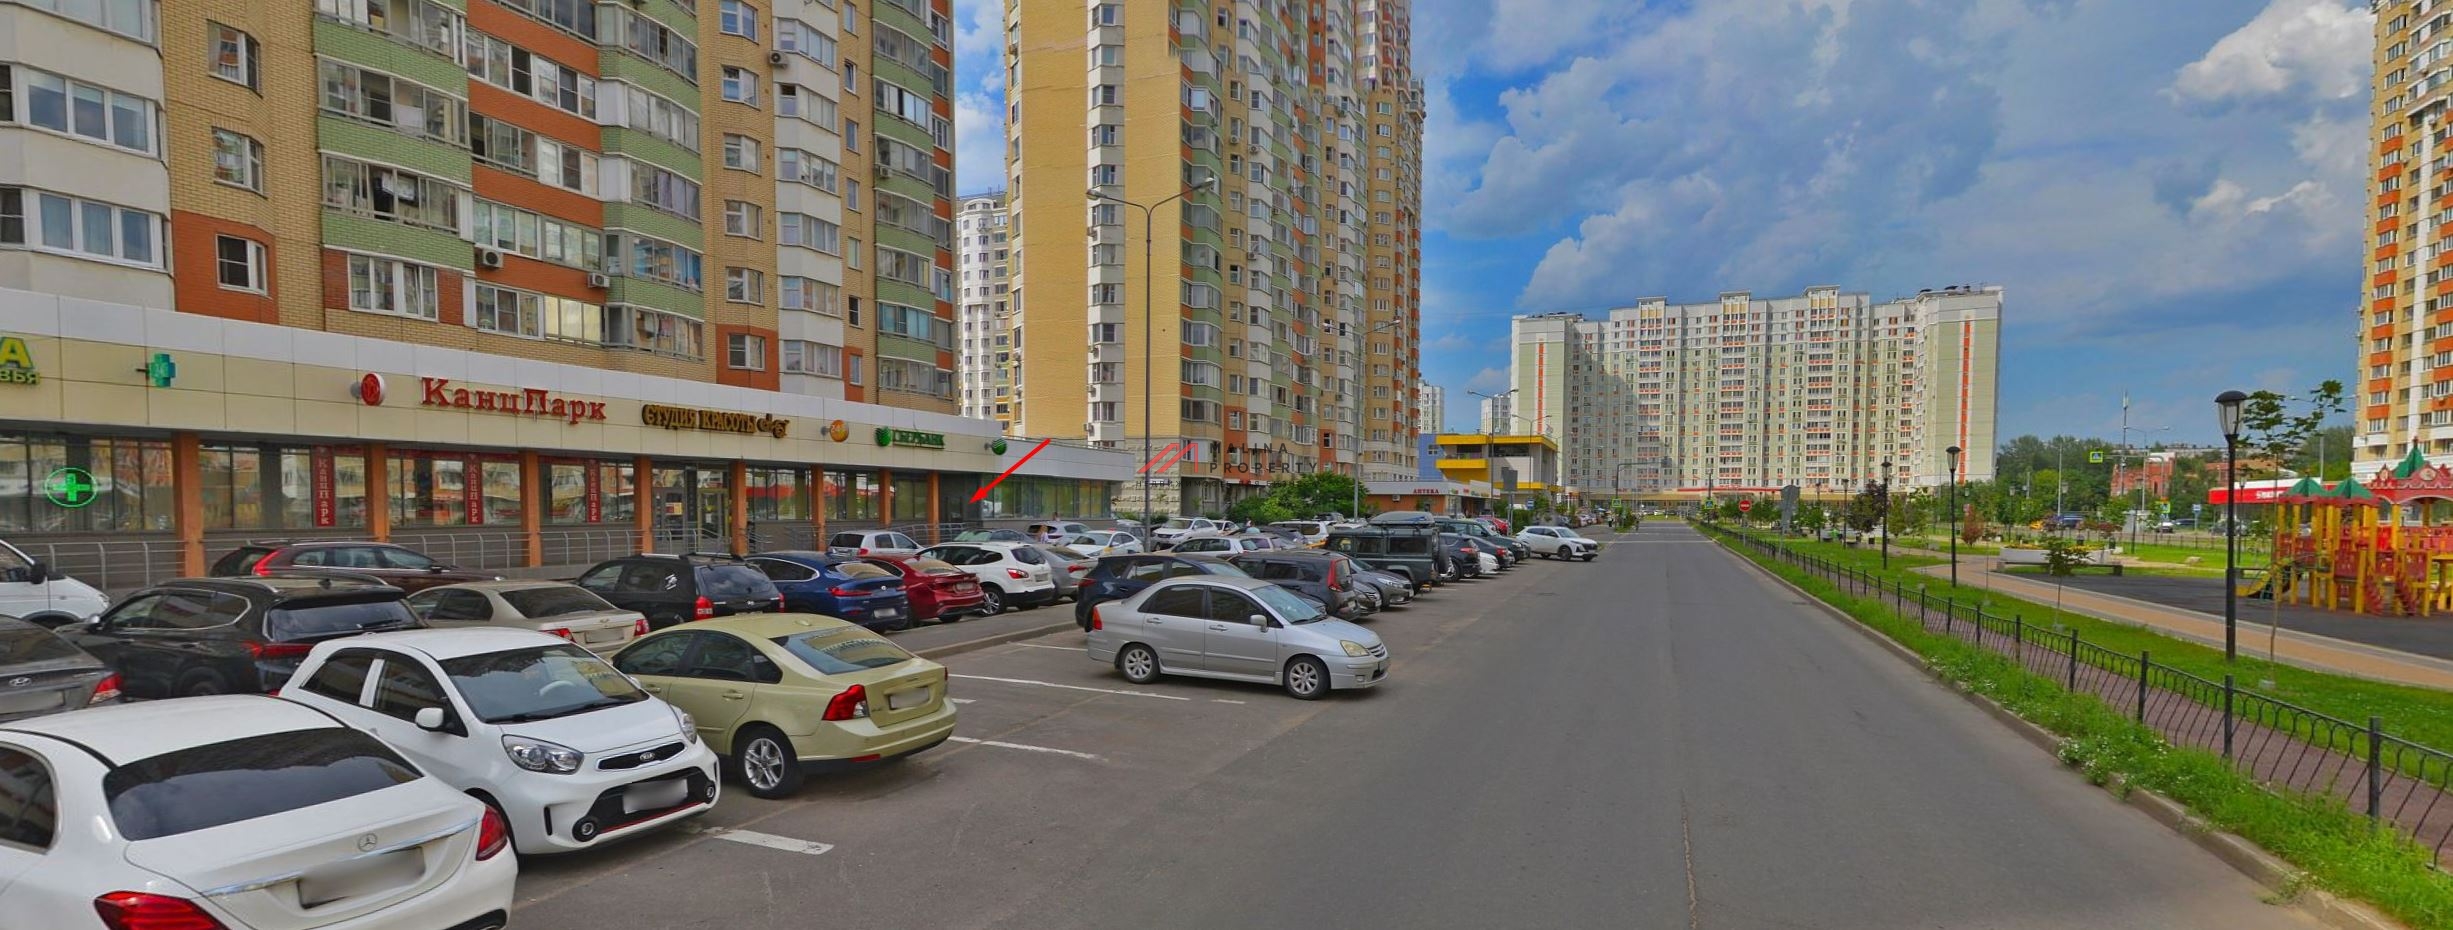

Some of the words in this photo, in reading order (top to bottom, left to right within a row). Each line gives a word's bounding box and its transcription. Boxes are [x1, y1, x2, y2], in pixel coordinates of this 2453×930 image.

[421, 376, 606, 425] КанцПарк
[642, 404, 697, 430] СТУДИЯ
[698, 409, 757, 433] КРАСОТЫ
